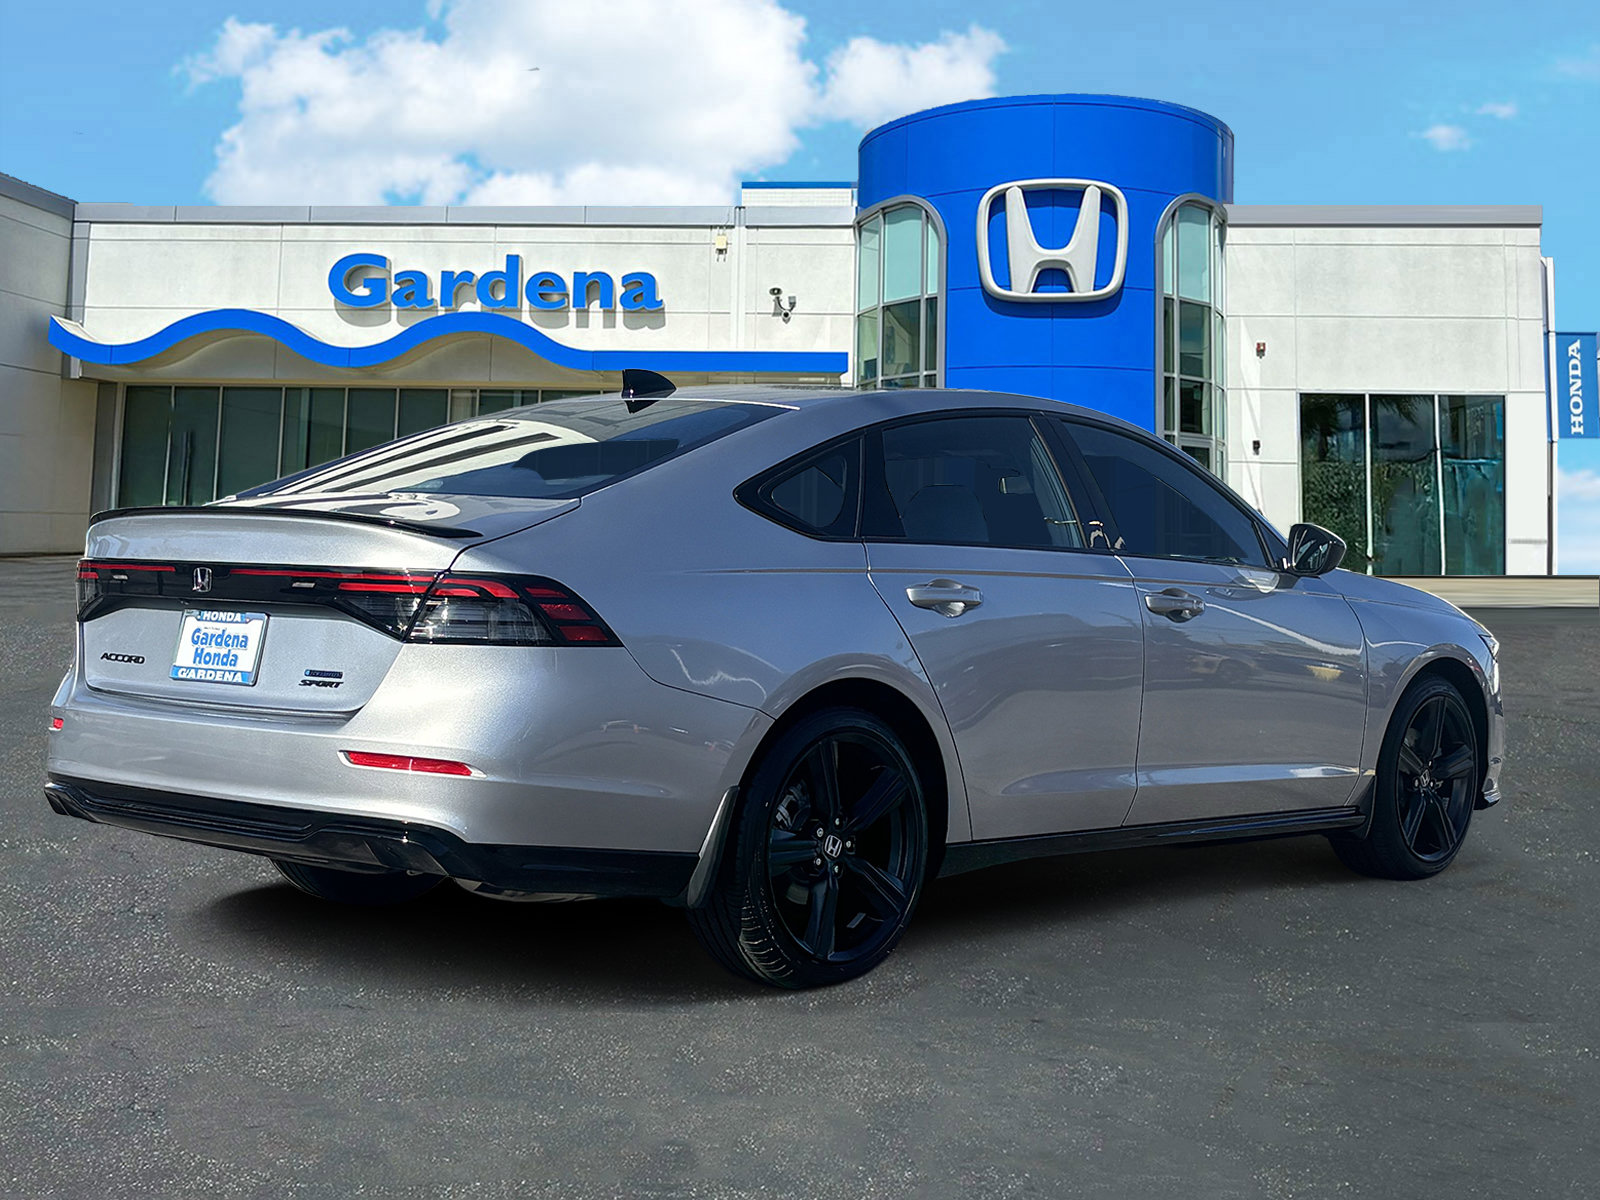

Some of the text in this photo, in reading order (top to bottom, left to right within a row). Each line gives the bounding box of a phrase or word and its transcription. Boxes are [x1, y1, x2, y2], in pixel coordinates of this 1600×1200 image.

[328, 252, 664, 310] Gardena
[1567, 339, 1584, 435] HONDA
[202, 610, 242, 622] HONDA
[191, 627, 249, 648] Gardena
[100, 652, 145, 664] ACCORD
[193, 647, 239, 667] Honda
[177, 667, 243, 683] GARDENA
